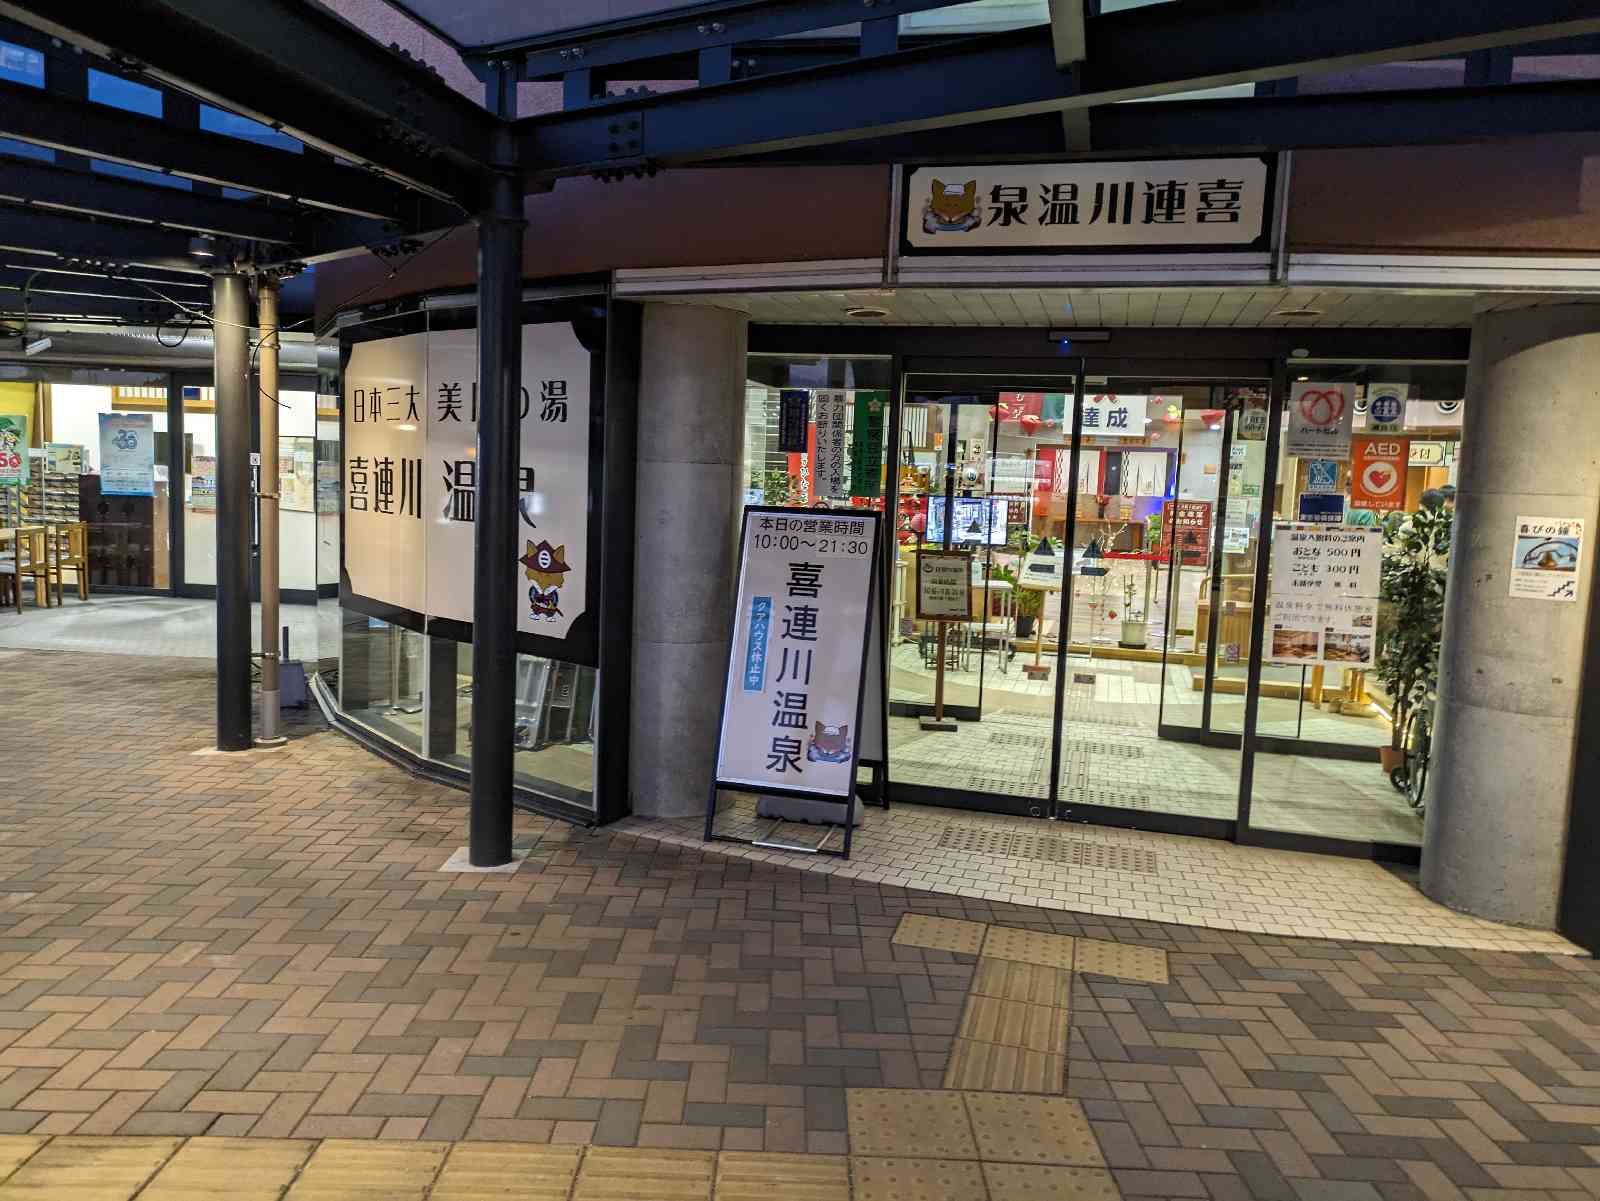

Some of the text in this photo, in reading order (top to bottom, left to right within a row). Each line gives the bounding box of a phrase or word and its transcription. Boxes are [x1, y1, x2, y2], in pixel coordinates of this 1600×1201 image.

[1364, 442, 1400, 456] AED
[759, 516, 865, 537] 本日の営業時間
[1292, 545, 1321, 557] おとな
[1292, 562, 1320, 573] こども
[748, 601, 767, 689] クアハウス休止中
[766, 562, 825, 774] 喜連川温泉
